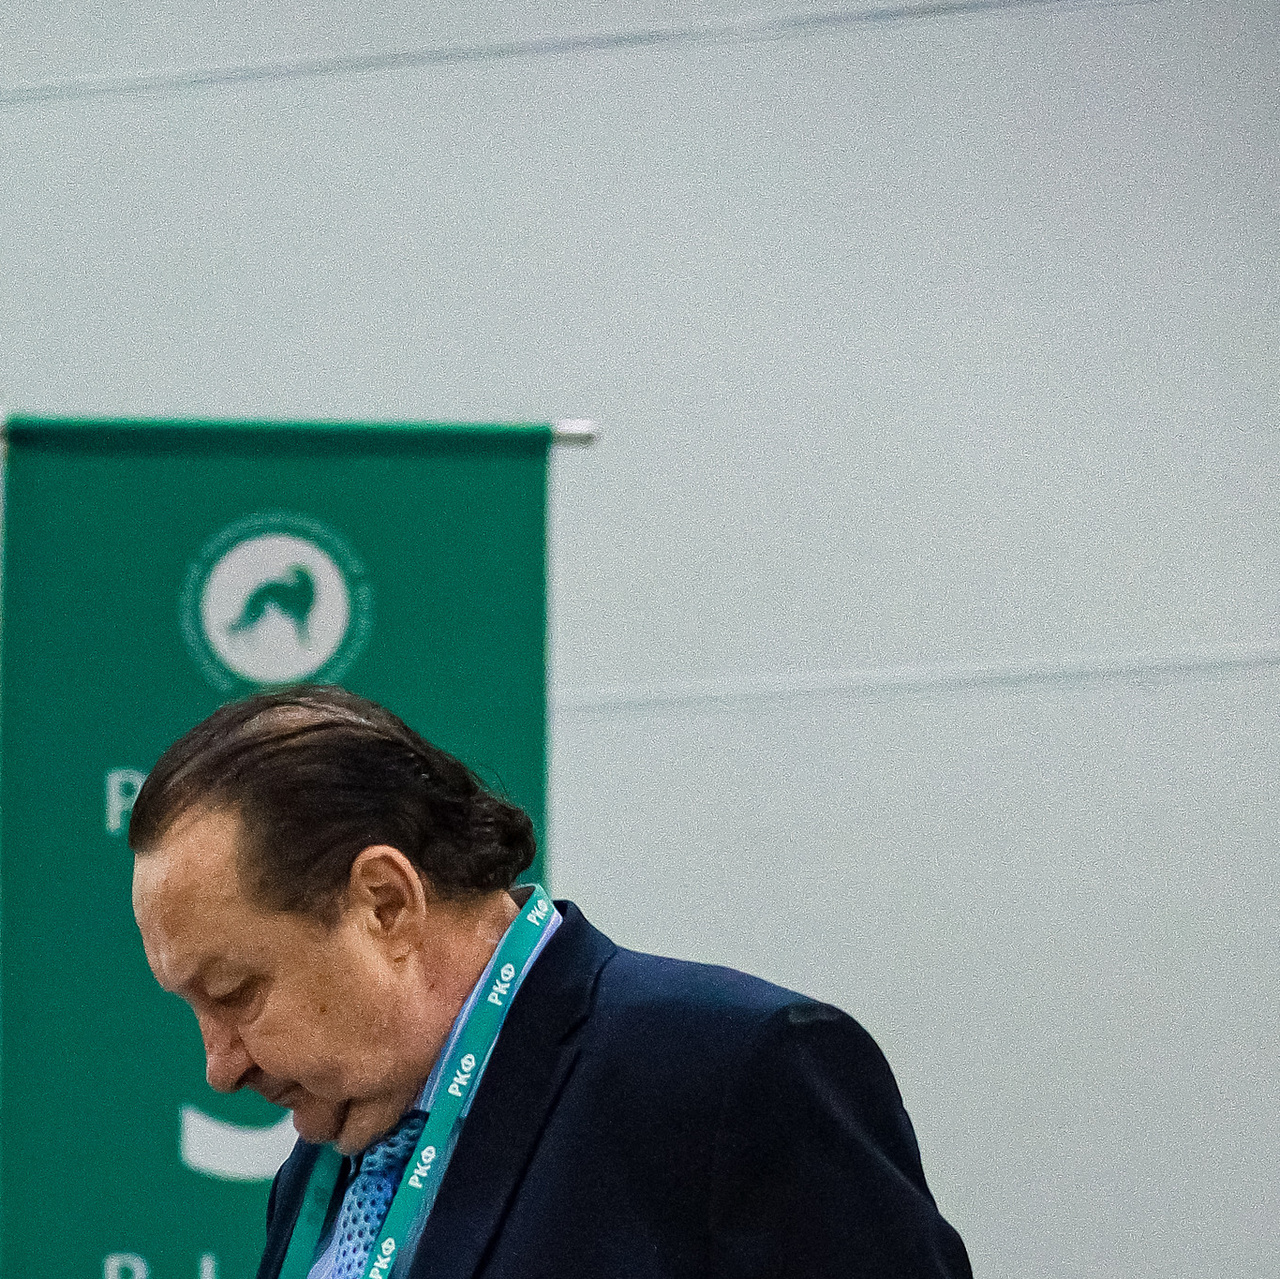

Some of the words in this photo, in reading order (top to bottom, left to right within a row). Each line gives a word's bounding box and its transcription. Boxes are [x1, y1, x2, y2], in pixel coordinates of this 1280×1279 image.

[487, 963, 516, 1006] РКФ
[447, 1053, 476, 1097] РКФ
[408, 1146, 437, 1189] РКФ
